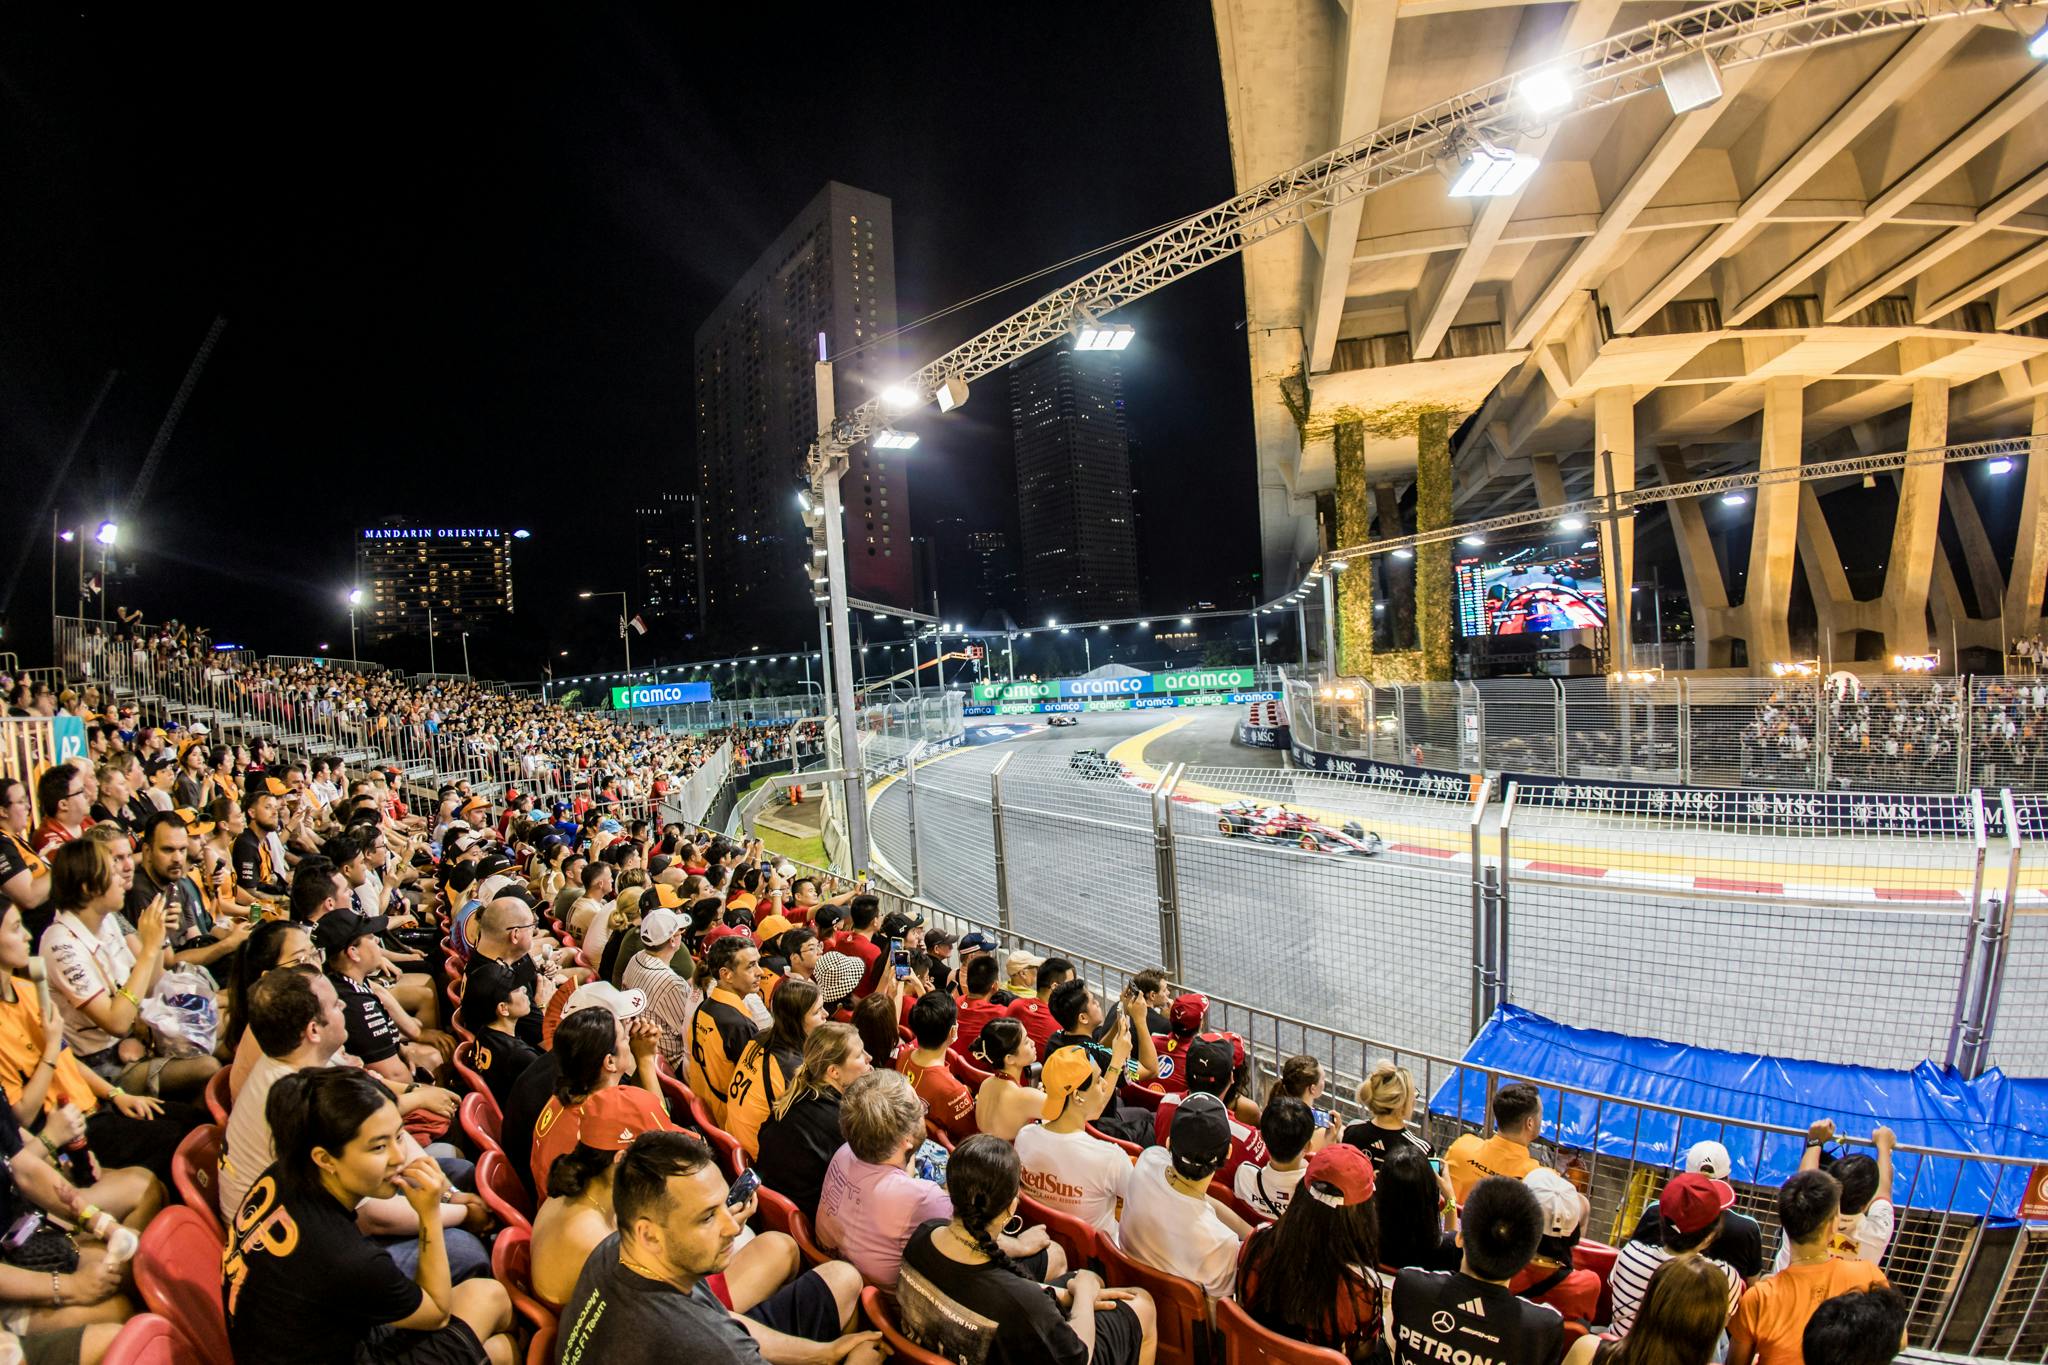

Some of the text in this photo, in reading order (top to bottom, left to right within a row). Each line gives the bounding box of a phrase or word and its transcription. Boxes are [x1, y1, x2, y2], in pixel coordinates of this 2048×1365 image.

[365, 529, 500, 538] MANDARIN ORIENTAL
[1071, 678, 1143, 694] aramco
[1165, 672, 1242, 689] aramco
[621, 687, 682, 704] aramco
[984, 684, 1050, 698] aramco
[1234, 692, 1274, 702] aramco
[1044, 703, 1080, 711] aramco
[1089, 701, 1126, 709] aramco
[1136, 698, 1174, 706] aramco
[1184, 695, 1223, 704] aramco
[964, 706, 992, 715] ramco
[1002, 704, 1036, 713] aramco
[1256, 730, 1275, 743] MSC
[60, 735, 81, 765] A2
[1336, 760, 1357, 774] MSC
[1379, 766, 1404, 782] MSC
[1432, 774, 1463, 791] MSC
[1574, 784, 1617, 801] MSC
[1672, 790, 1719, 810] MSC
[1774, 797, 1822, 815] MSC
[1878, 802, 1927, 822] MSC
[1983, 806, 2031, 826] MC
[631, 996, 642, 1008] 44
[729, 1070, 753, 1107] 81
[906, 1274, 936, 1304] SCUDERIA
[934, 1300, 965, 1326] FERRARI
[964, 1322, 978, 1331] HP
[579, 1331, 589, 1349] F1
[585, 1300, 607, 1333] Team
[1471, 1330, 1500, 1344] AMG
